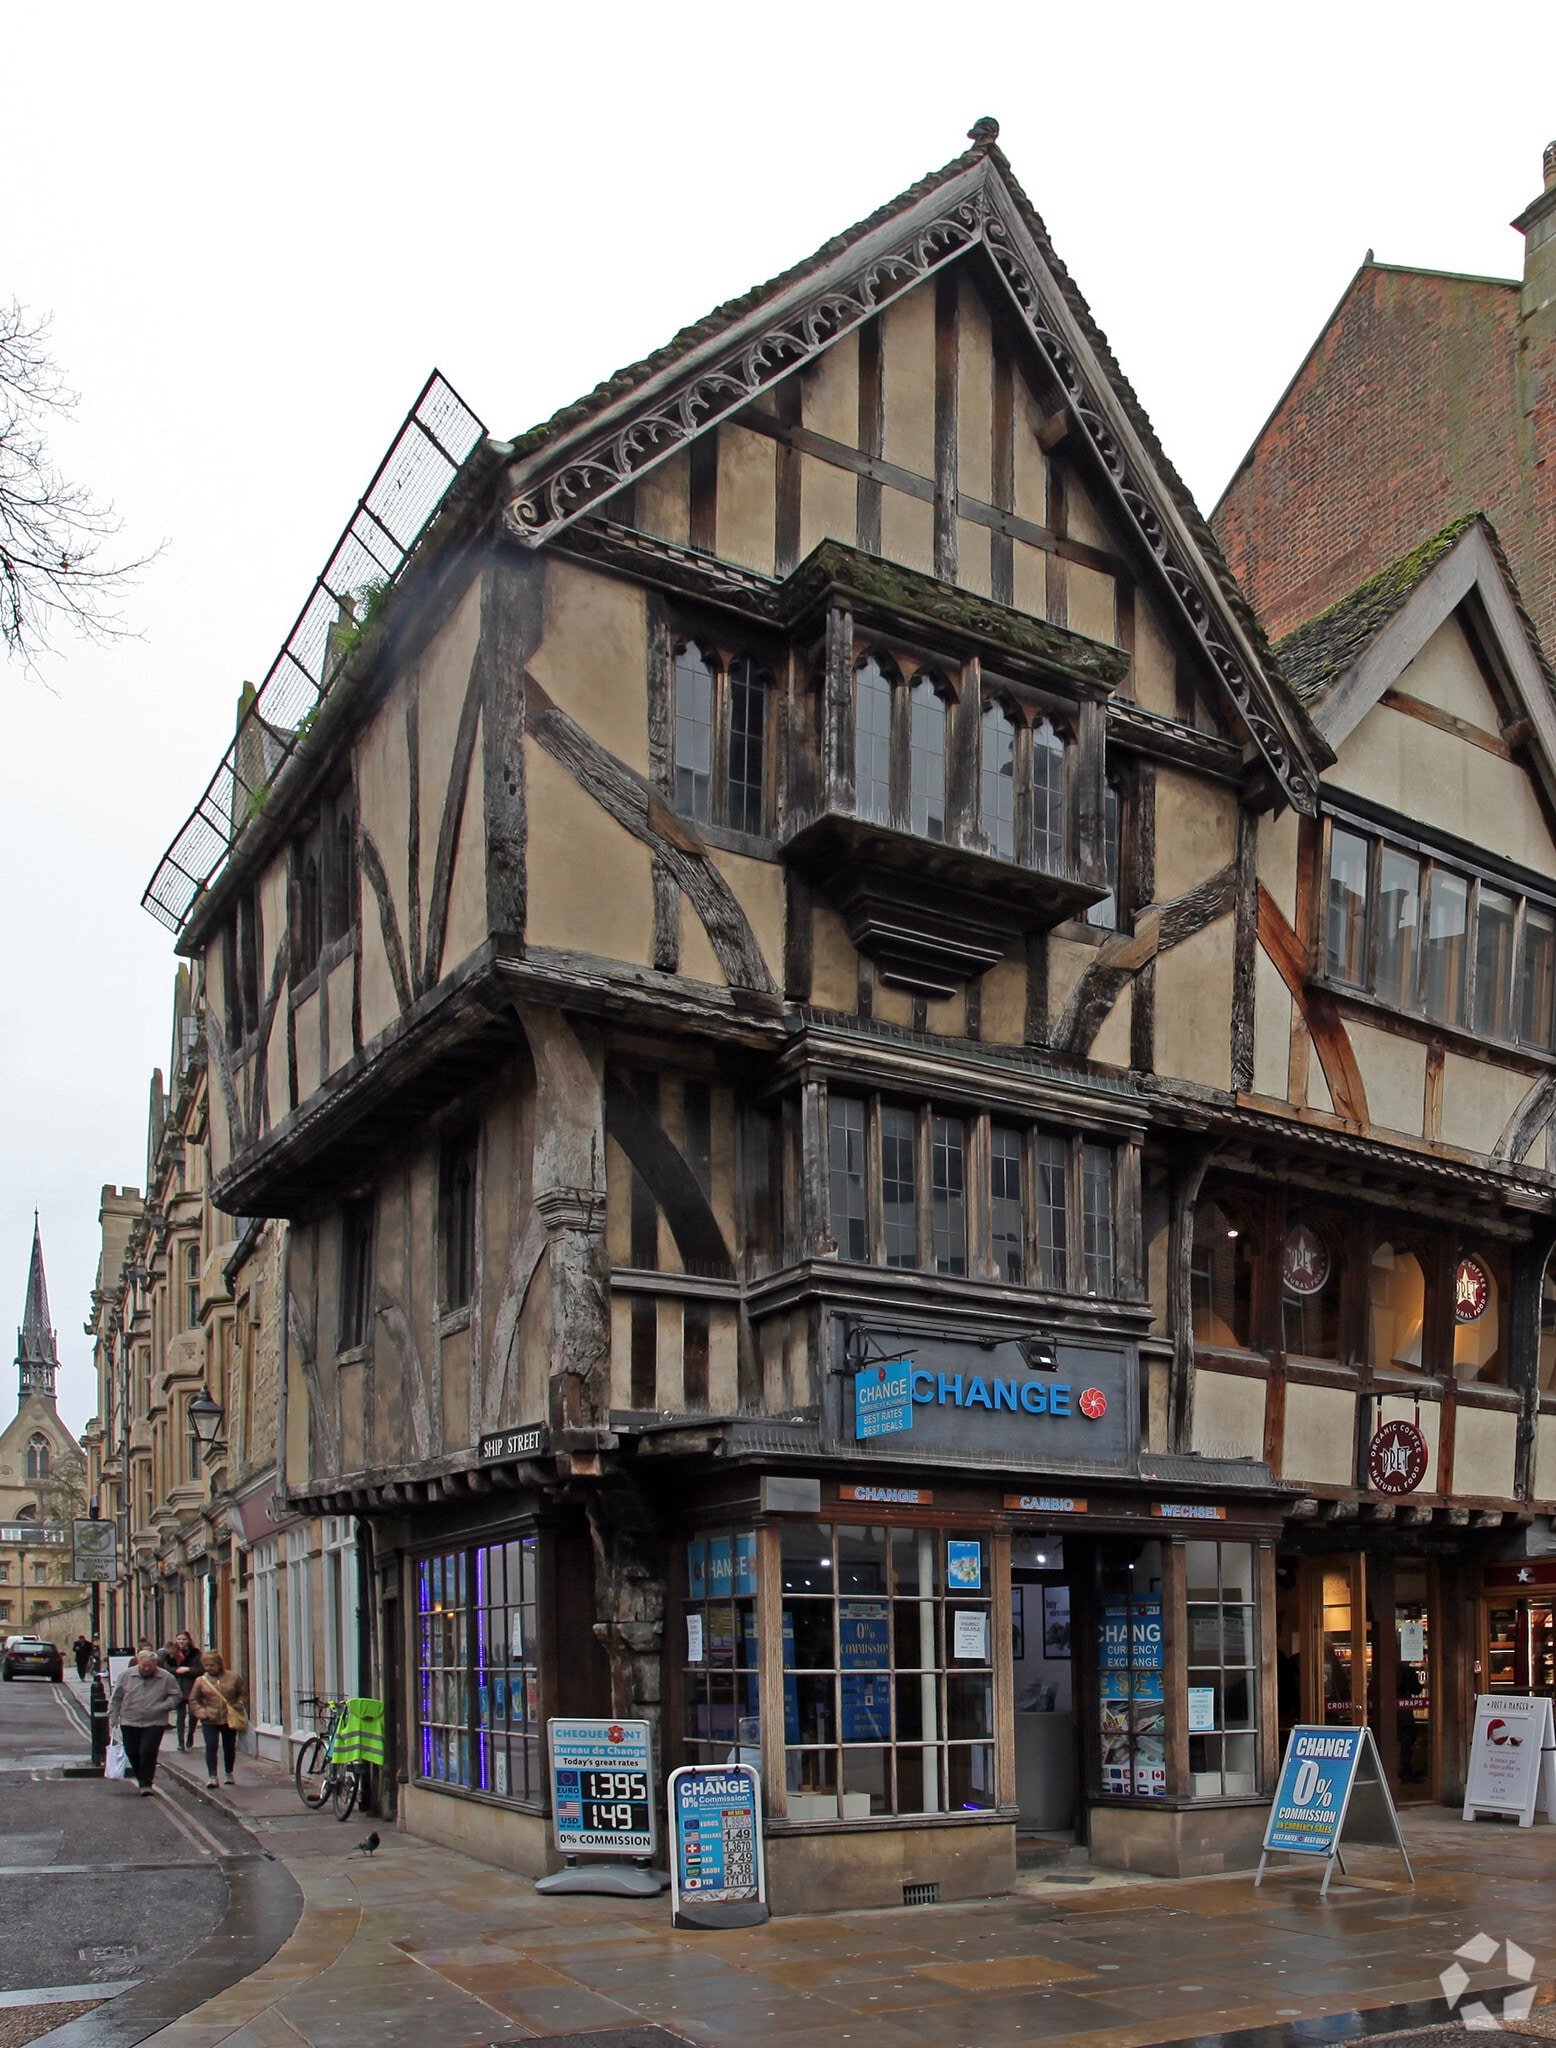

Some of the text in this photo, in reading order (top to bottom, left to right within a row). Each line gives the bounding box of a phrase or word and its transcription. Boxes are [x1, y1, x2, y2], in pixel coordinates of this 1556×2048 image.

[1311, 1269, 1324, 1286] FOOD
[1468, 1262, 1486, 1288] COFFEE
[1456, 1280, 1477, 1300] PRET
[1474, 1299, 1485, 1315] FOOD
[859, 1378, 907, 1404] CHANGE
[911, 1370, 1072, 1416] CHANGE
[863, 1408, 903, 1425] BEST RATES
[863, 1419, 904, 1436] BEST DEALS
[483, 1430, 541, 1458] SHIP STREET
[1370, 1423, 1422, 1458] ORGANIC COFFEE
[1381, 1445, 1410, 1473] PRET
[1372, 1466, 1420, 1492] NATURAL FOOD
[854, 1486, 919, 1503] CHANGE
[1020, 1496, 1074, 1511] CAMBIO
[1160, 1504, 1221, 1519] WECHSEL
[856, 1622, 876, 1640] 0%
[1107, 1645, 1158, 1655] CURENCY
[1107, 1657, 1158, 1667] EXCANGE
[553, 1745, 647, 1757] Bureau de Change
[1296, 1736, 1353, 1758] CHANGE
[563, 1757, 639, 1768] Today's great rates
[590, 1773, 647, 1800] 1.395
[680, 1780, 751, 1797] CHANGE
[1292, 1759, 1334, 1808] 0%
[682, 1796, 699, 1809] 0%
[592, 1803, 633, 1830] 1.49
[1278, 1806, 1337, 1823] COMMISSION
[725, 1829, 750, 1841] 1.49
[1284, 1821, 1315, 1832] CURRENCY
[1315, 1824, 1333, 1834] SALES
[560, 1834, 651, 1846] 0% COMMISSION
[701, 1841, 751, 1853] CHF 1.3670
[1316, 1837, 1331, 1845] DEALS
[727, 1852, 753, 1864] 5.49
[726, 1863, 751, 1876] 5.38
[702, 1874, 752, 1886] YEN 171.01
